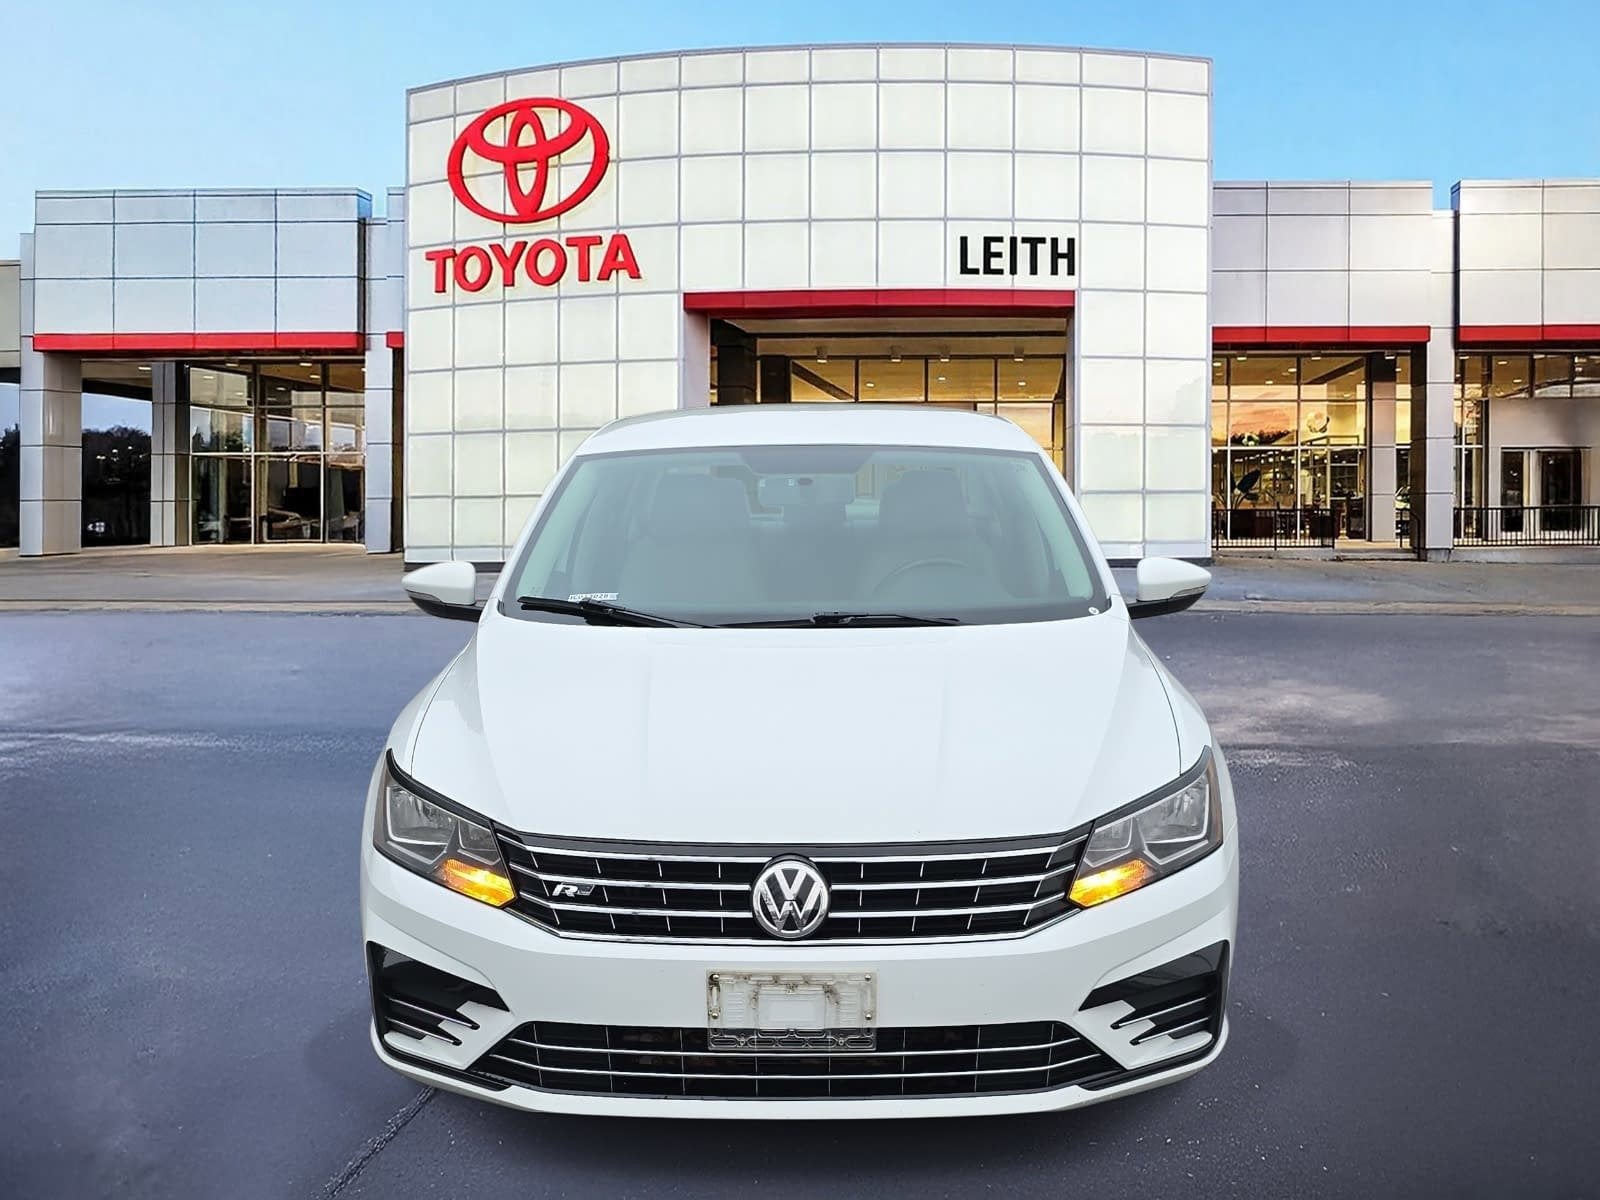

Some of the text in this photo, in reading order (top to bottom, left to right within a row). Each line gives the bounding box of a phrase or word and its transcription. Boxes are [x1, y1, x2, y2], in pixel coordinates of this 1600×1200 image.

[425, 233, 641, 293] TOYOTA
[960, 236, 1075, 276] LEITH
[756, 864, 825, 935] VW
